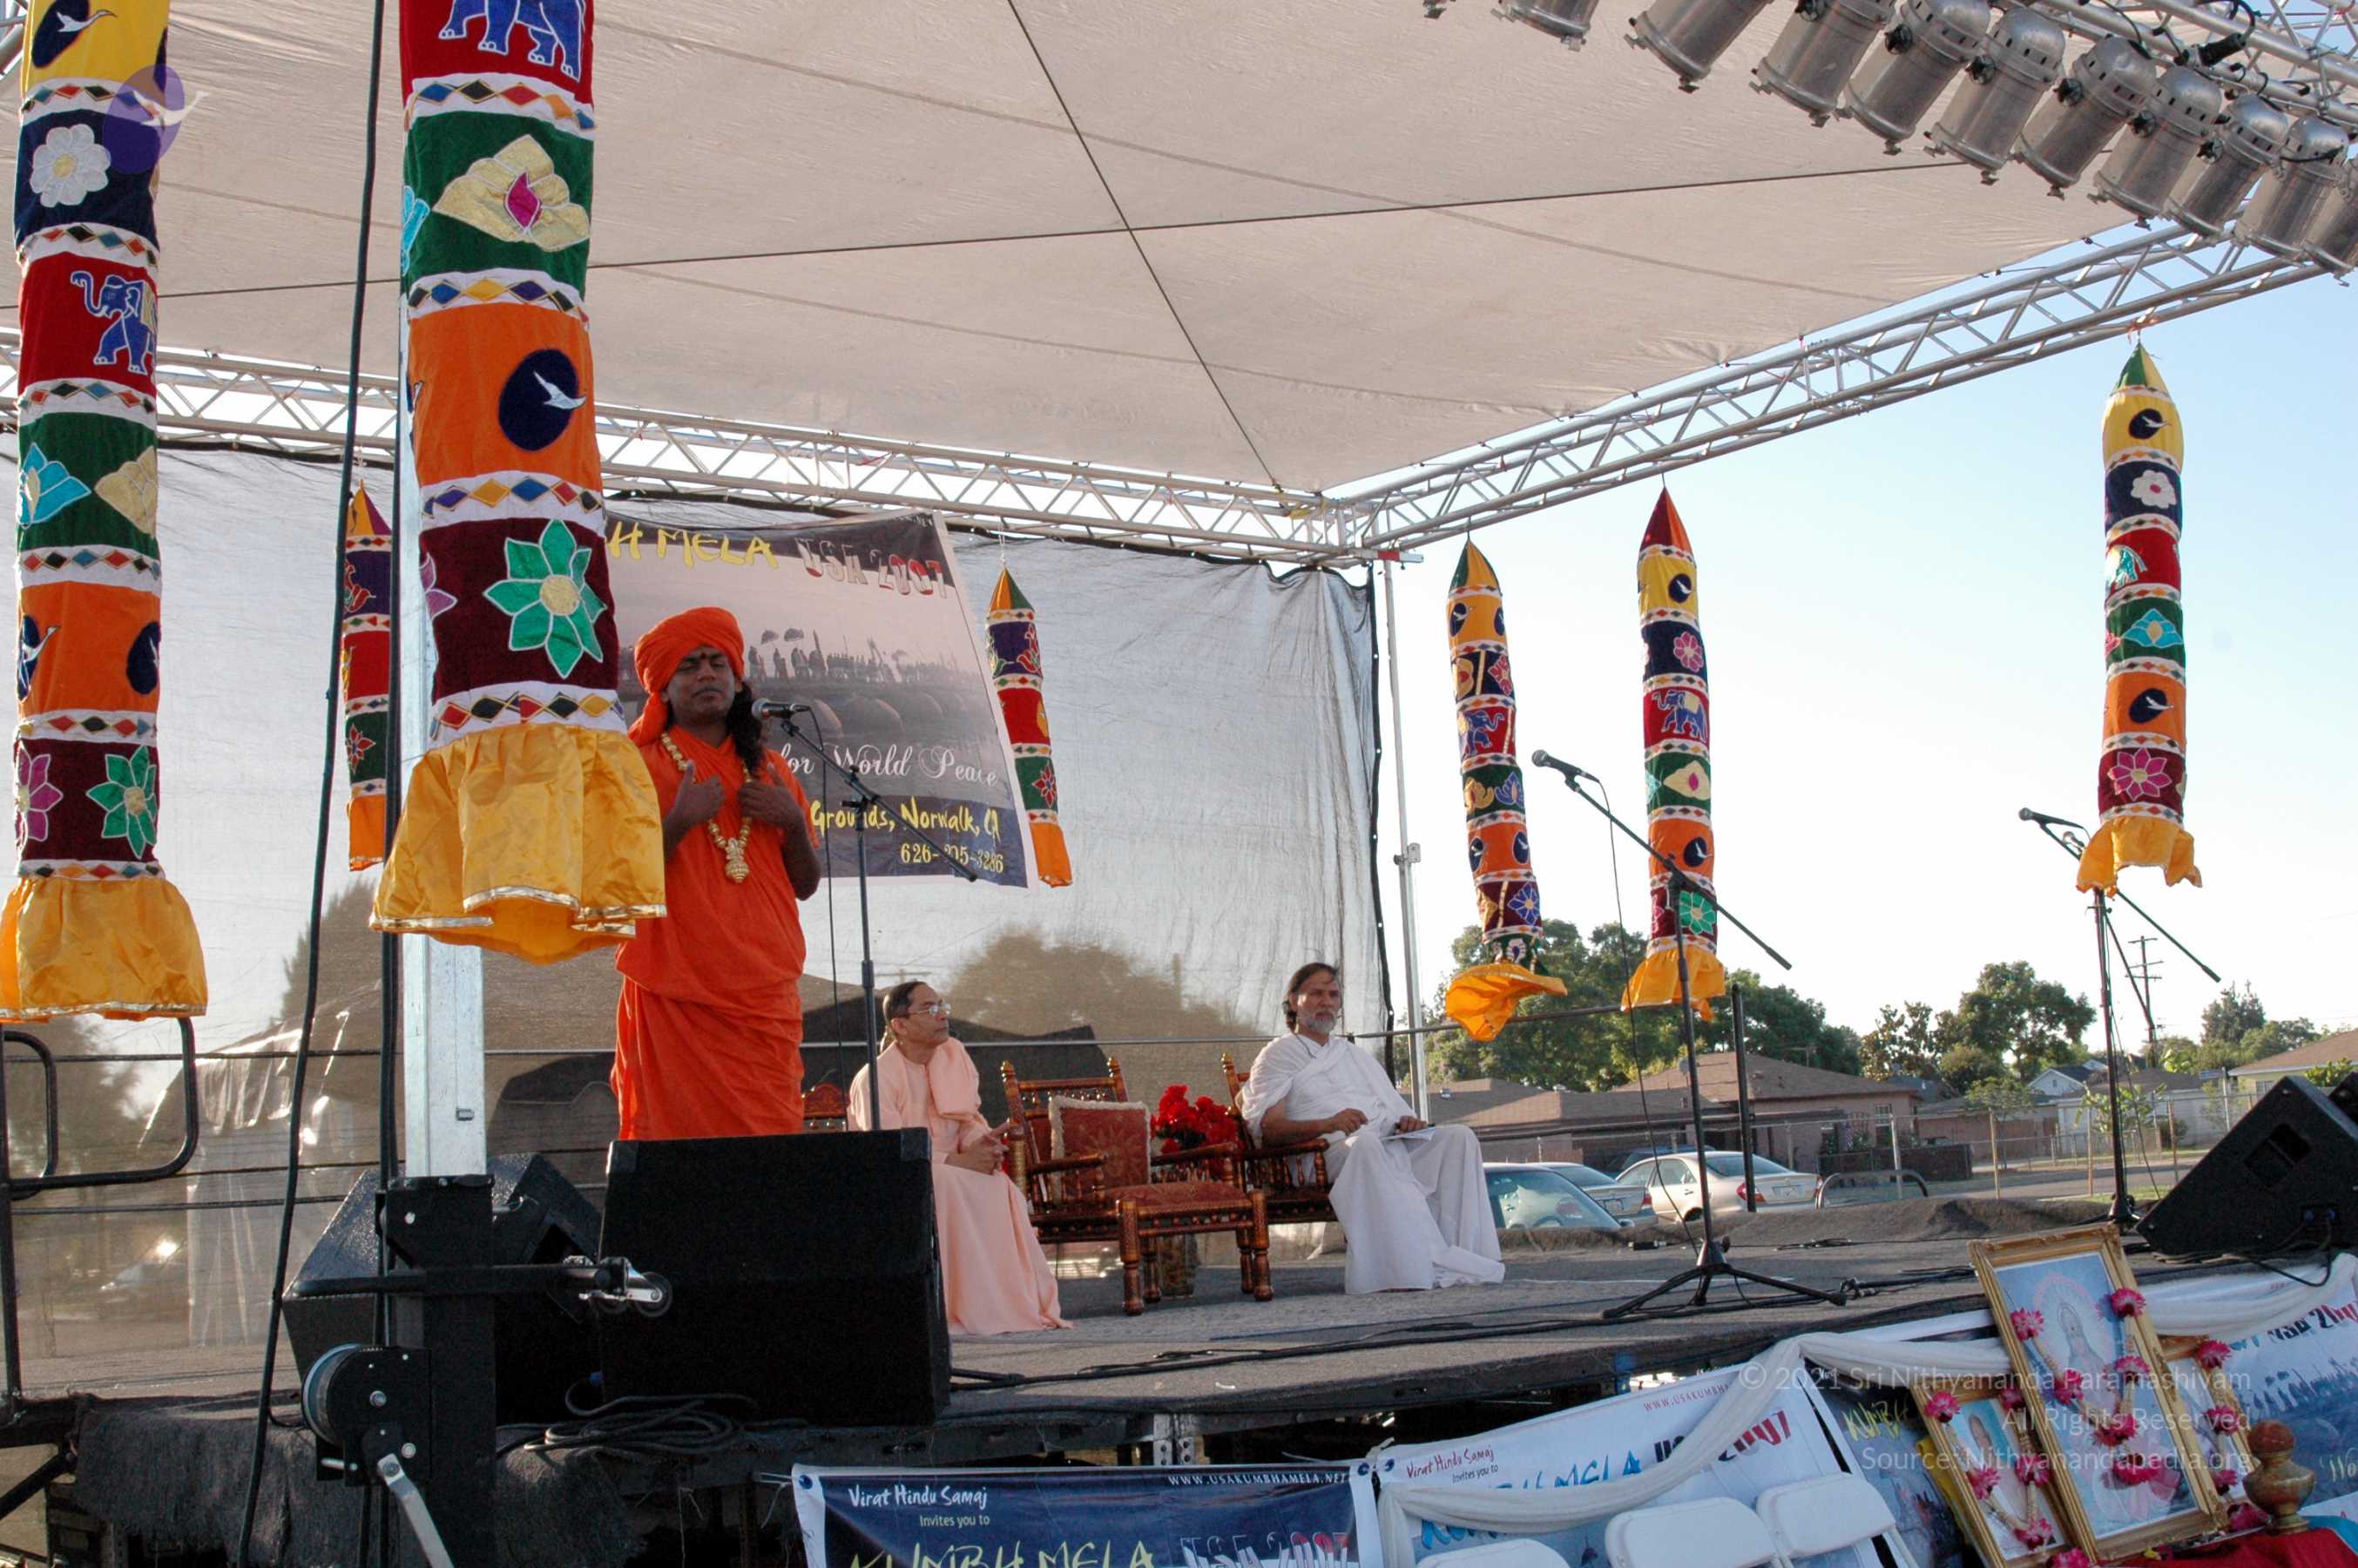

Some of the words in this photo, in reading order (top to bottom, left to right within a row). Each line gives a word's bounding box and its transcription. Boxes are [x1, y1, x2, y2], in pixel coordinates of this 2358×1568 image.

[657, 528, 780, 569] MELA
[822, 744, 914, 776] World
[919, 746, 998, 787] Peace
[809, 800, 895, 837] Grouds,
[900, 795, 981, 836] Norwalk,
[1406, 1461, 1434, 1479] Virat
[1434, 1451, 1463, 1471] Hindu
[1463, 1444, 1495, 1464] Samaj
[1452, 1470, 1476, 1484] Invites
[1476, 1469, 1490, 1480] you
[1169, 1472, 1348, 1486] WWW.USAKUMBHAMELA.NET
[848, 1484, 892, 1507] Virat
[894, 1484, 937, 1506] Hindu
[940, 1485, 988, 1511] Samaj
[919, 1515, 955, 1527] Invites
[956, 1516, 976, 1529] you
[978, 1515, 990, 1525] to
